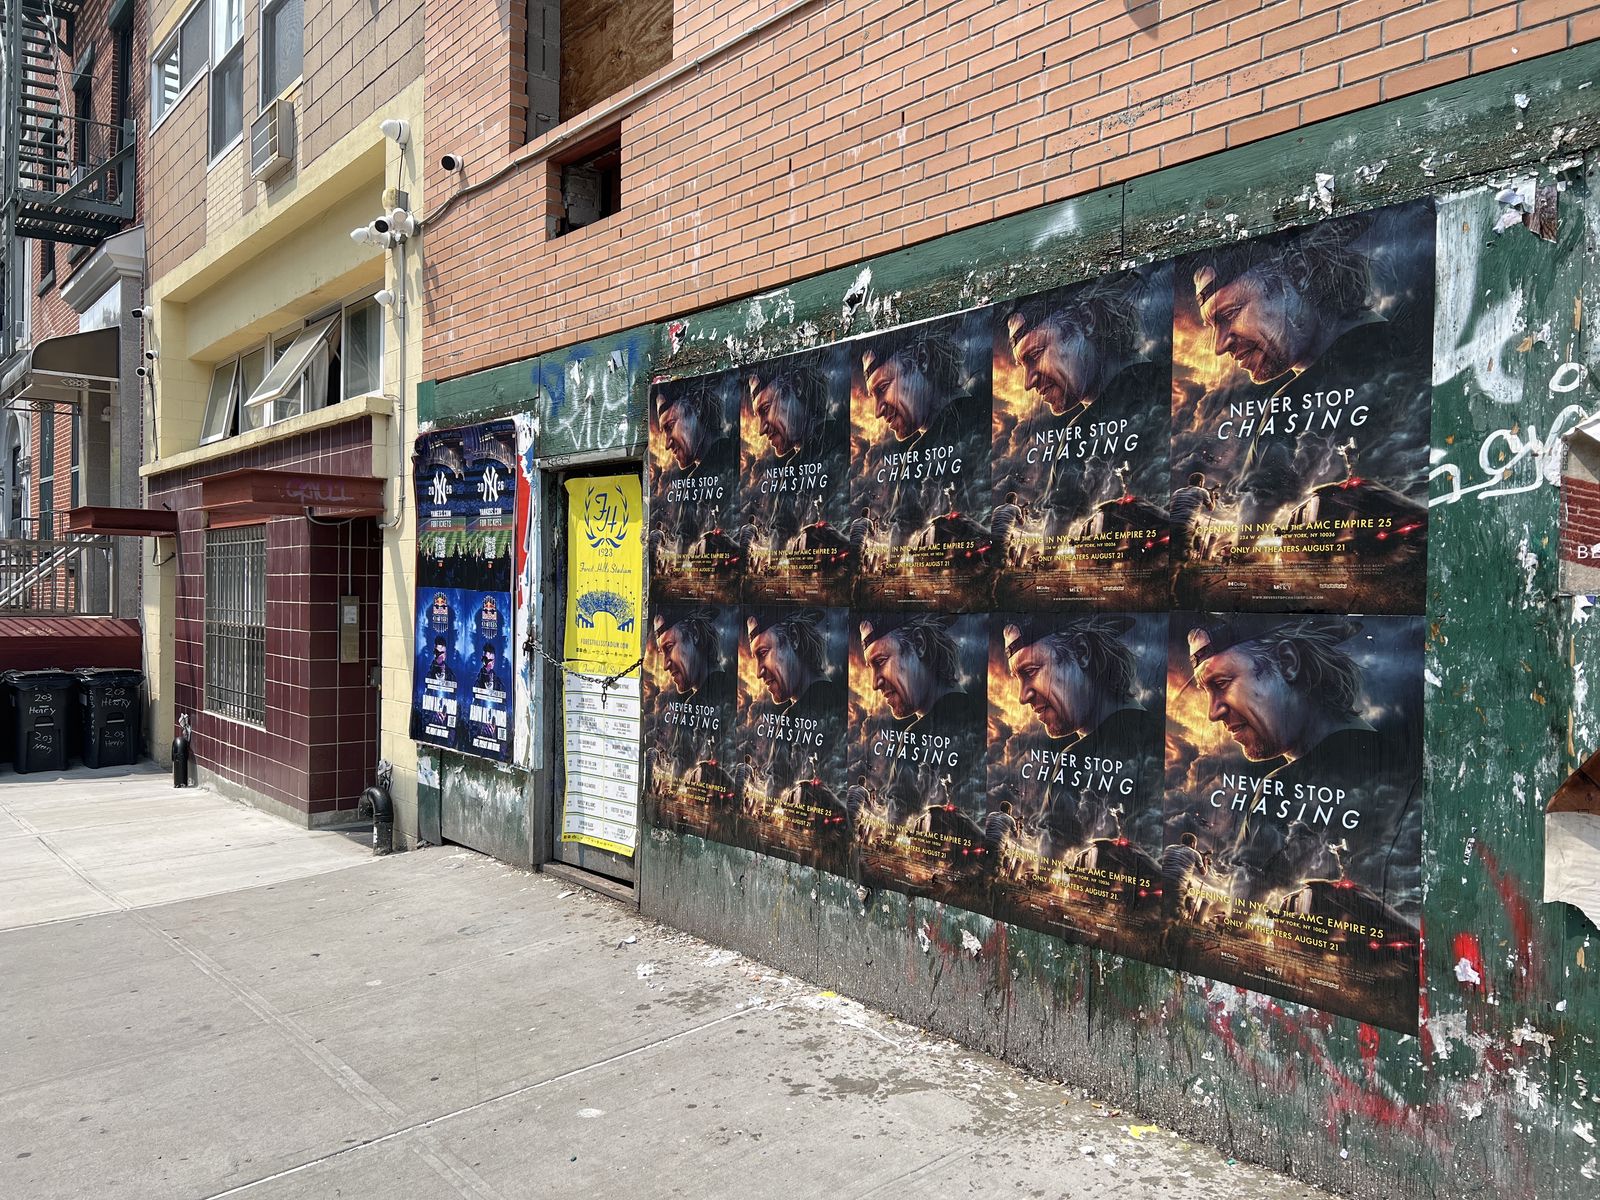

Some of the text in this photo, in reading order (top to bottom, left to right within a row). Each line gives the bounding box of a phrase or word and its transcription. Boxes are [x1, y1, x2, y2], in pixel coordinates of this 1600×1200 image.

[1230, 388, 1355, 419] NEVER STOP
[1035, 419, 1128, 446] NEVER STOP
[1217, 405, 1369, 441] CHASING
[883, 445, 954, 467] NEVER STOP
[1026, 434, 1139, 464] CHASING
[766, 462, 822, 479] NEVER STOP
[877, 458, 962, 483] CHASING
[433, 470, 447, 505] NY
[482, 466, 499, 503] NY
[672, 476, 719, 490] NEVER STOP
[760, 474, 828, 494] CHASING
[667, 487, 724, 503] CHASING
[1195, 524, 1238, 534] OPENING
[1241, 523, 1252, 532] IN
[1256, 523, 1277, 532] NYC
[1306, 520, 1331, 530] AMC
[1334, 519, 1374, 529] EMPIRE
[1378, 518, 1392, 528] 25
[943, 542, 964, 550] EMPIRE
[966, 541, 975, 549] 25
[1011, 537, 1043, 545] OPENING
[1093, 532, 1112, 540] AMC
[1115, 530, 1143, 539] EMPIRE
[1146, 530, 1157, 538] 25
[598, 548, 613, 557] 1923
[1061, 553, 1089, 561] THEATERS
[1091, 552, 1115, 560] AUGUST
[1230, 546, 1250, 554] ONLY
[1264, 545, 1300, 553] THEATERS
[1301, 544, 1334, 552] AUGUST
[34, 693, 52, 702] 203
[105, 687, 125, 696] 203
[28, 707, 56, 715] Henry
[669, 701, 715, 716] NEVER STOP
[664, 712, 720, 730] CHASING
[762, 713, 818, 731] NEVER STOP
[34, 731, 52, 743] 203
[104, 730, 125, 738] 203
[757, 724, 824, 747] CHASING
[881, 729, 951, 749] NEVER STOP
[874, 742, 959, 767] CHASING
[1030, 748, 1123, 774] NEVER STOP
[1021, 763, 1134, 795] CHASING
[1223, 773, 1346, 805] NEVER STOP
[807, 805, 824, 815] EMPIRE
[1210, 790, 1361, 829] CHASING
[924, 831, 938, 840] AMC
[940, 833, 961, 845] EMPIRE
[963, 839, 971, 847] 25
[921, 848, 940, 858] AUGUST
[1005, 848, 1039, 861] OPENING
[1041, 856, 1048, 864] IN
[1051, 859, 1066, 868] NYC
[1088, 868, 1106, 878] AMC
[1109, 871, 1137, 885] EMPIRE
[1140, 878, 1151, 887] 25
[1032, 874, 1048, 883] ONLY
[1056, 879, 1083, 892] THEATERS
[1085, 887, 1109, 898] AUGUST
[1188, 888, 1231, 904] OPENING
[1235, 898, 1245, 907] IN
[1249, 901, 1269, 913] NYC
[1283, 910, 1295, 919] THE
[1299, 912, 1324, 925] AMC
[1327, 918, 1366, 935] EMPIRE
[1370, 928, 1384, 939] 25
[1224, 918, 1243, 928] ONLY
[1256, 926, 1292, 940] THEATERS
[1295, 934, 1327, 948] AUGUST
[1330, 942, 1339, 951] 21
